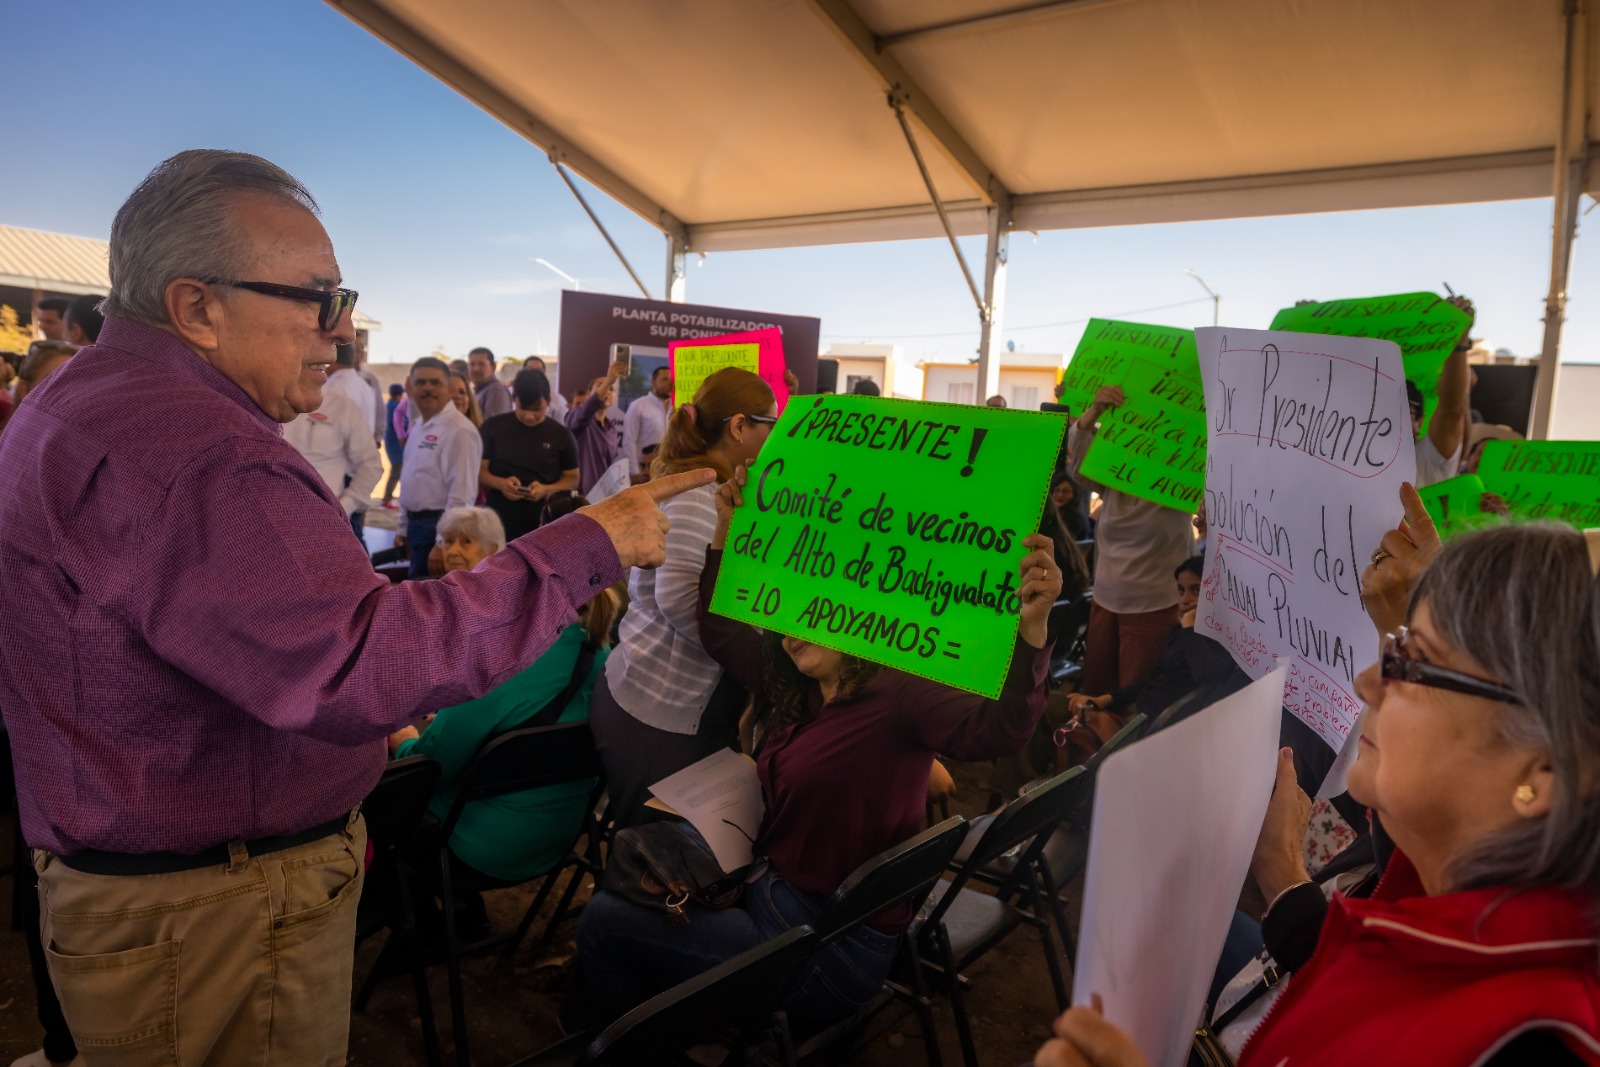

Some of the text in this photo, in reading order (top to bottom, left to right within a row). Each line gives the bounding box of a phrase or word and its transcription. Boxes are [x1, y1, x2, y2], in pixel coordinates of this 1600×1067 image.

[612, 306, 667, 323] PLANTA
[650, 325, 677, 337] SUR
[700, 348, 750, 364] PRESIDENTE
[788, 397, 989, 478] ¡PRESENTE!
[1257, 343, 1393, 467] Presidente
[756, 458, 1017, 554] Comité de vecinos
[733, 521, 1023, 617] del Alto de Bachigualato
[1217, 553, 1266, 624] CANAL
[1313, 504, 1365, 612] del
